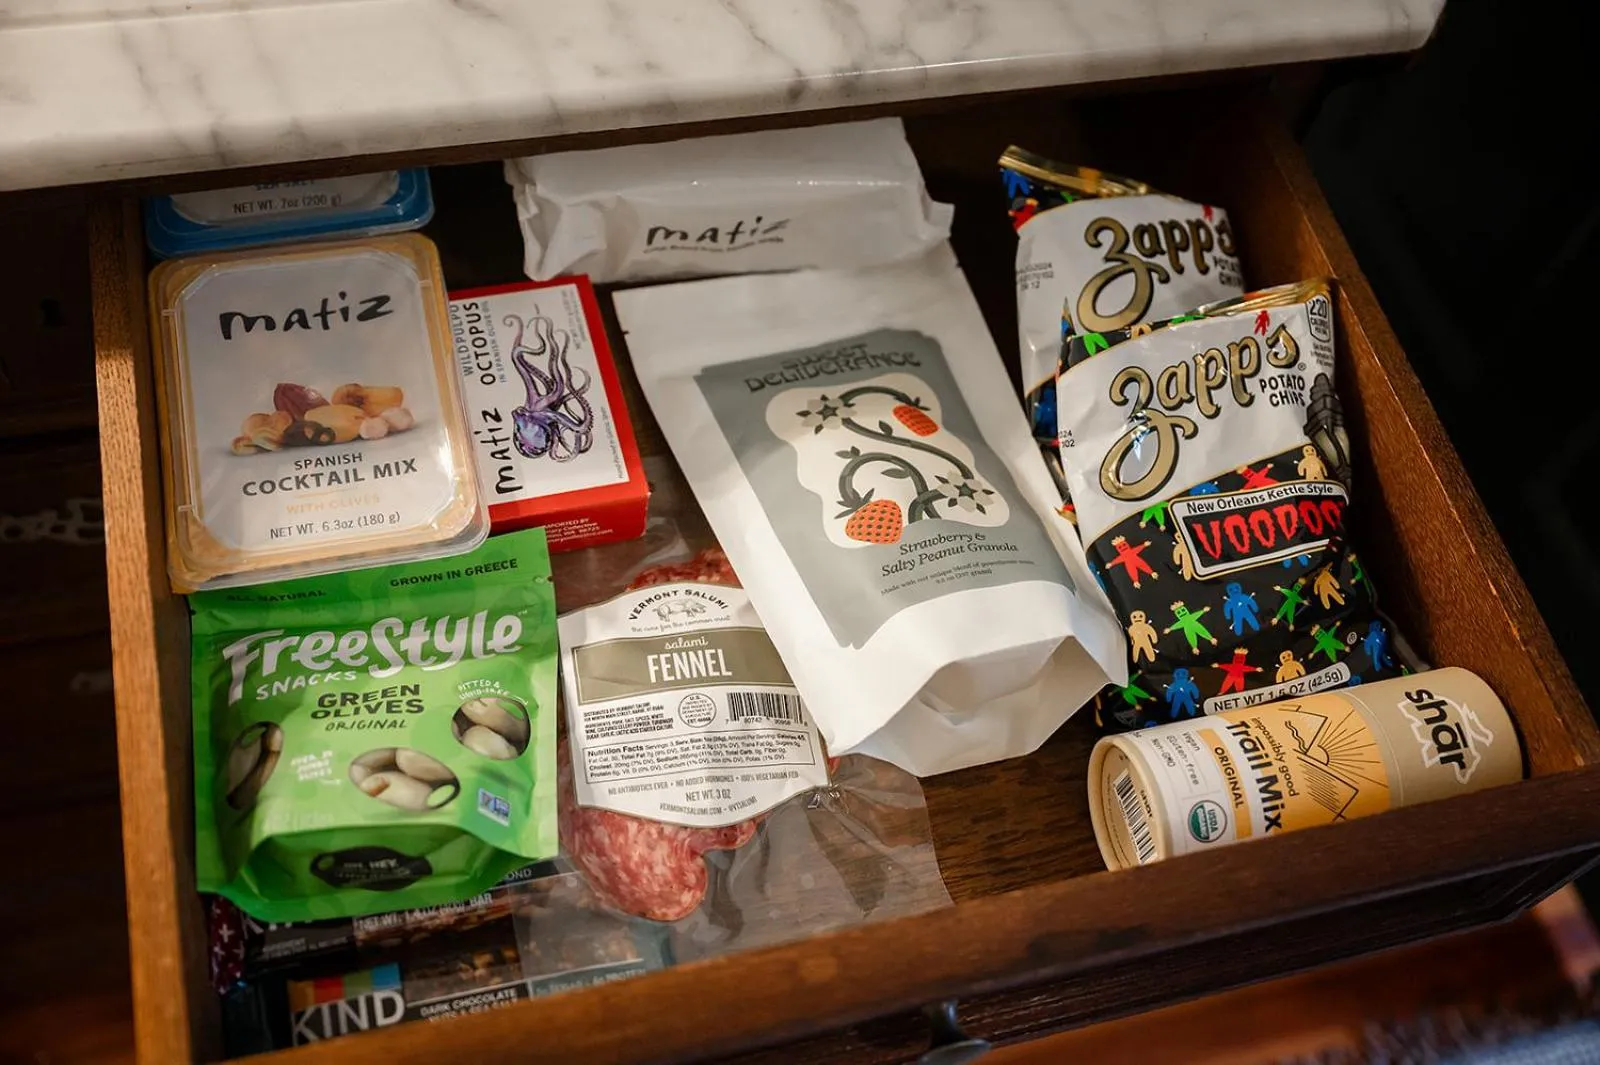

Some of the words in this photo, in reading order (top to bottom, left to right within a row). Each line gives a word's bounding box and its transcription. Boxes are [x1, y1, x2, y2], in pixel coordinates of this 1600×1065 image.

[233, 202, 253, 214] NET
[220, 291, 394, 340] matiz
[463, 302, 496, 386] OCTOPUS
[1259, 374, 1305, 394] POTATO
[1268, 391, 1306, 408] CHIPS
[294, 452, 363, 471] SPANISH
[474, 407, 523, 495] matiz
[242, 468, 365, 497] COCKTAIL
[374, 458, 418, 479] MIX
[286, 501, 324, 515] WITH
[329, 493, 381, 510] OLIVES
[1187, 500, 1214, 514] New
[1216, 493, 1265, 511] Orleans
[1267, 485, 1305, 500] Kettle
[1306, 484, 1334, 495] Style
[270, 522, 293, 539] NET
[296, 521, 318, 535] WT.
[322, 518, 354, 533] 6.3oz
[358, 512, 385, 528] (180
[389, 511, 401, 525] g)
[544, 519, 579, 530] MPORTED
[1191, 500, 1344, 560] VOODOO
[900, 532, 973, 556] Strawberry
[975, 533, 986, 541] &
[390, 573, 443, 587] GROWN
[446, 568, 461, 580] IN
[465, 559, 518, 577] GREECE
[882, 558, 916, 577] Salty
[918, 546, 966, 566] Peanut
[966, 543, 1018, 553] Granola
[258, 589, 327, 602] NATURAL
[629, 590, 679, 622] VERMONT
[684, 588, 729, 610] SALUMI
[222, 609, 523, 706] FreeStyle
[664, 636, 709, 651] salami
[647, 648, 733, 683] FENNEL
[256, 671, 357, 700] SNACKS
[317, 684, 421, 709] GREEN
[1214, 697, 1243, 712] NET
[1243, 693, 1265, 706] WT
[1289, 681, 1306, 696] OZ
[1308, 668, 1343, 692] (42.5g)
[311, 699, 425, 719] OLIVES
[325, 718, 408, 732] ORIGINAL
[587, 746, 621, 757] Nutrition
[622, 744, 644, 753] Facts
[1151, 738, 1176, 768] Non-GMO
[1182, 731, 1201, 752] Vegan
[1214, 746, 1245, 809] ORIGINAL
[1279, 765, 1300, 797] good
[686, 791, 700, 802] NET
[1255, 774, 1285, 832] Mix
[1206, 808, 1219, 834] USDA
[420, 1003, 450, 1017] DARK
[452, 988, 516, 1010] CHOCOLATE
[291, 990, 405, 1047] KIND
